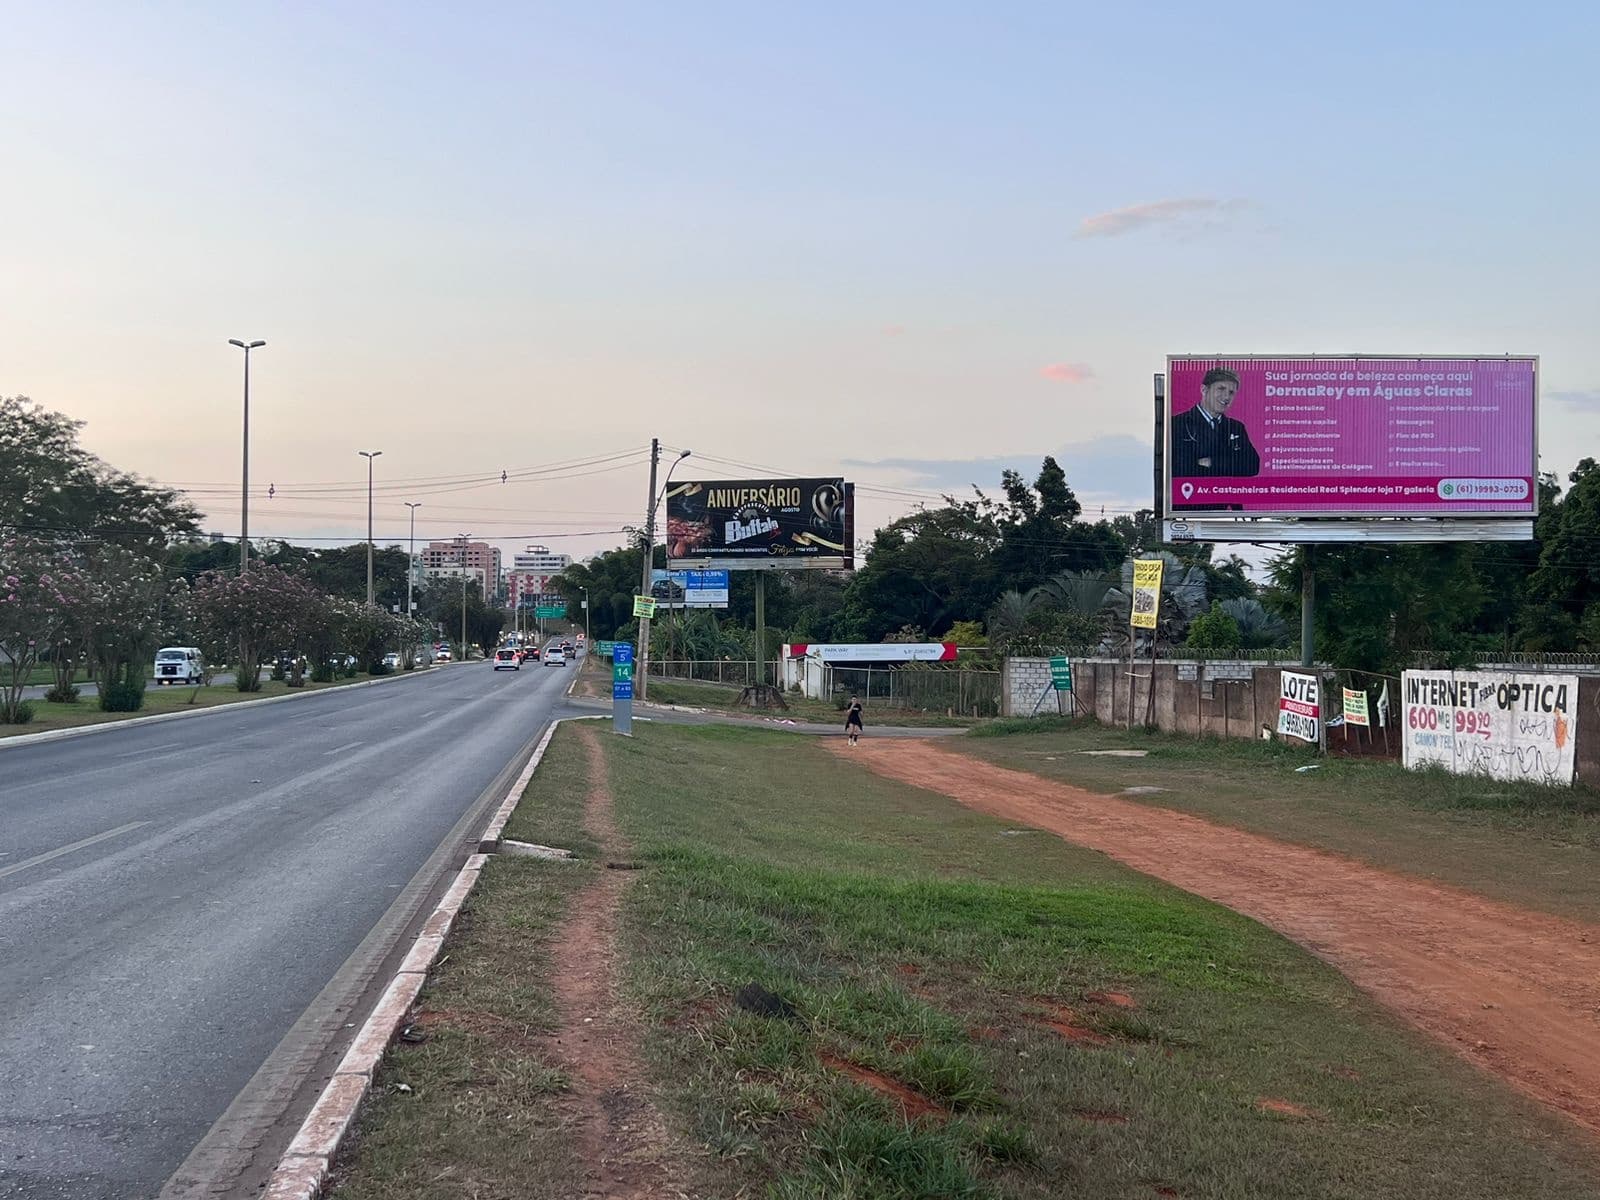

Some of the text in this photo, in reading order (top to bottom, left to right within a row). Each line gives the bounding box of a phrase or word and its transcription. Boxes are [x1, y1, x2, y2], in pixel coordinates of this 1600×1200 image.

[1265, 371, 1473, 384] Sua jornada de beleza começa aqui
[1265, 381, 1473, 400] DermaRey em Águas Claras
[707, 484, 800, 508] ANIVERSÁRIO
[1198, 486, 1212, 494] Av.
[1212, 486, 1269, 494] Castanheiras
[1270, 486, 1318, 494] Residencial
[1340, 486, 1376, 496] Splendor
[1378, 486, 1394, 496] loja
[1404, 486, 1435, 495] galeria
[1456, 484, 1472, 494] (61)
[725, 516, 779, 544] Buffalo
[620, 654, 626, 662] 5
[617, 668, 628, 676] 14
[1282, 676, 1317, 703] LOTE
[1408, 678, 1478, 708] INTERNET
[1409, 706, 1438, 730] 600
